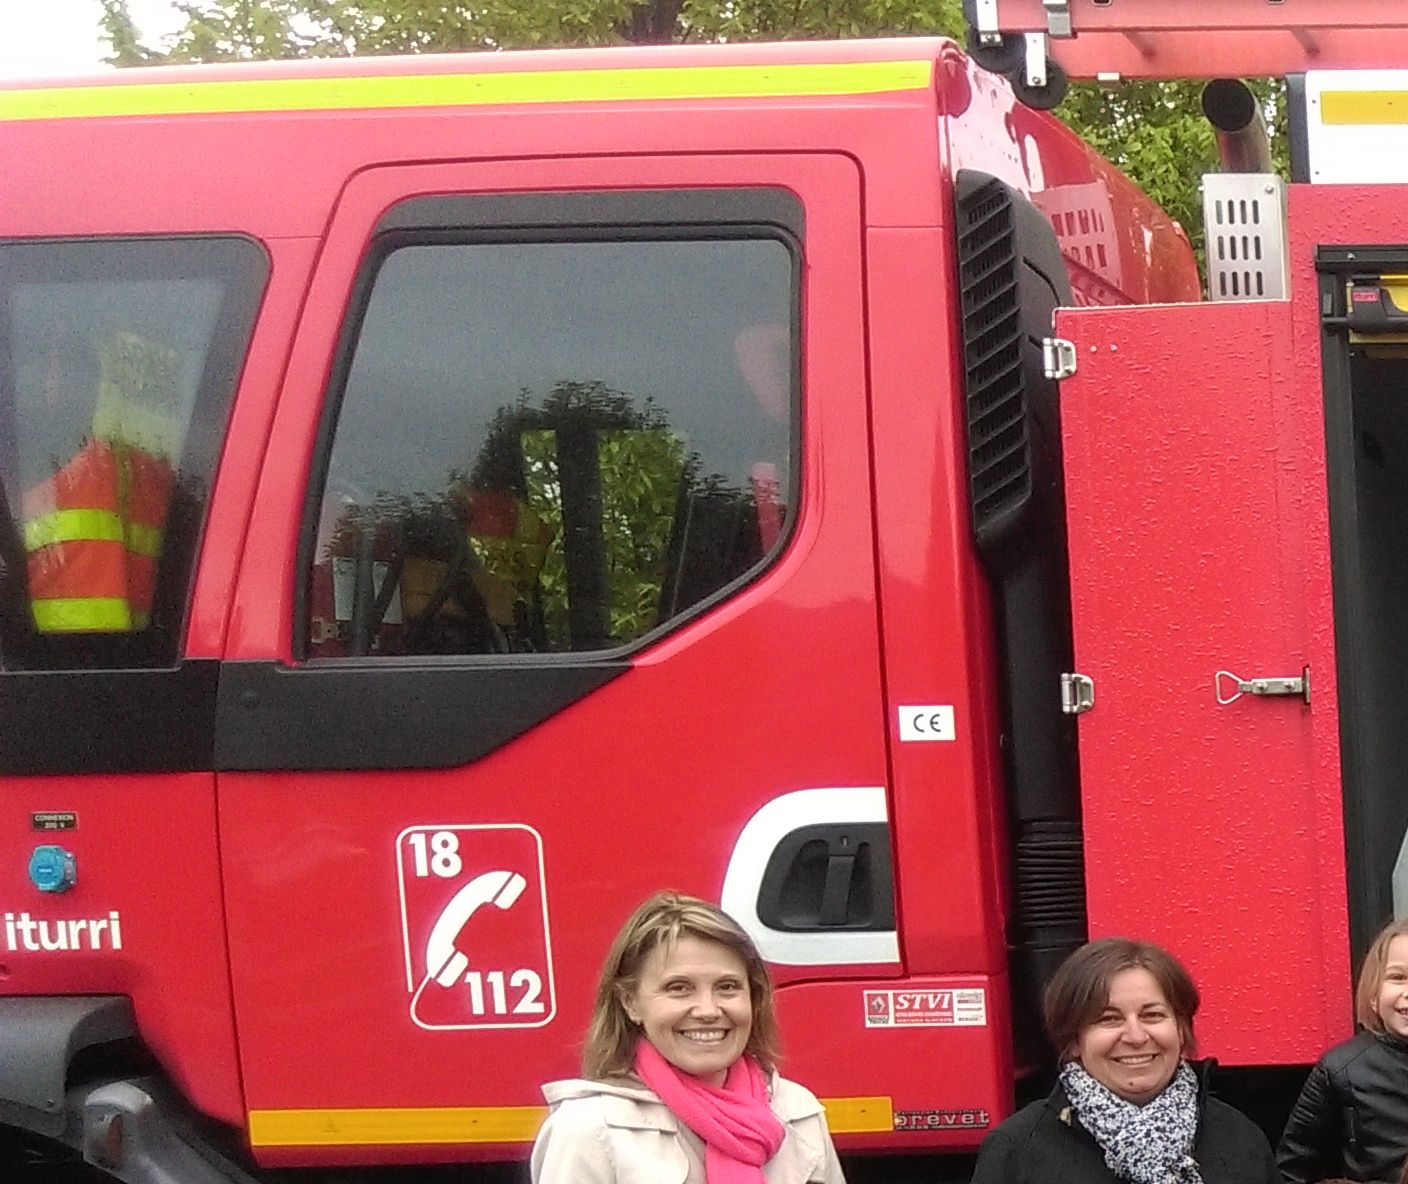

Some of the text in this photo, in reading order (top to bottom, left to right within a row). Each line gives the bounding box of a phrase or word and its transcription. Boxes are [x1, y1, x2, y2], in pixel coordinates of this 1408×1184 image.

[913, 713, 941, 733] CE
[409, 831, 462, 878] 18
[4, 910, 122, 951] iturri
[465, 968, 545, 1016] 112
[895, 993, 951, 1010] STVI
